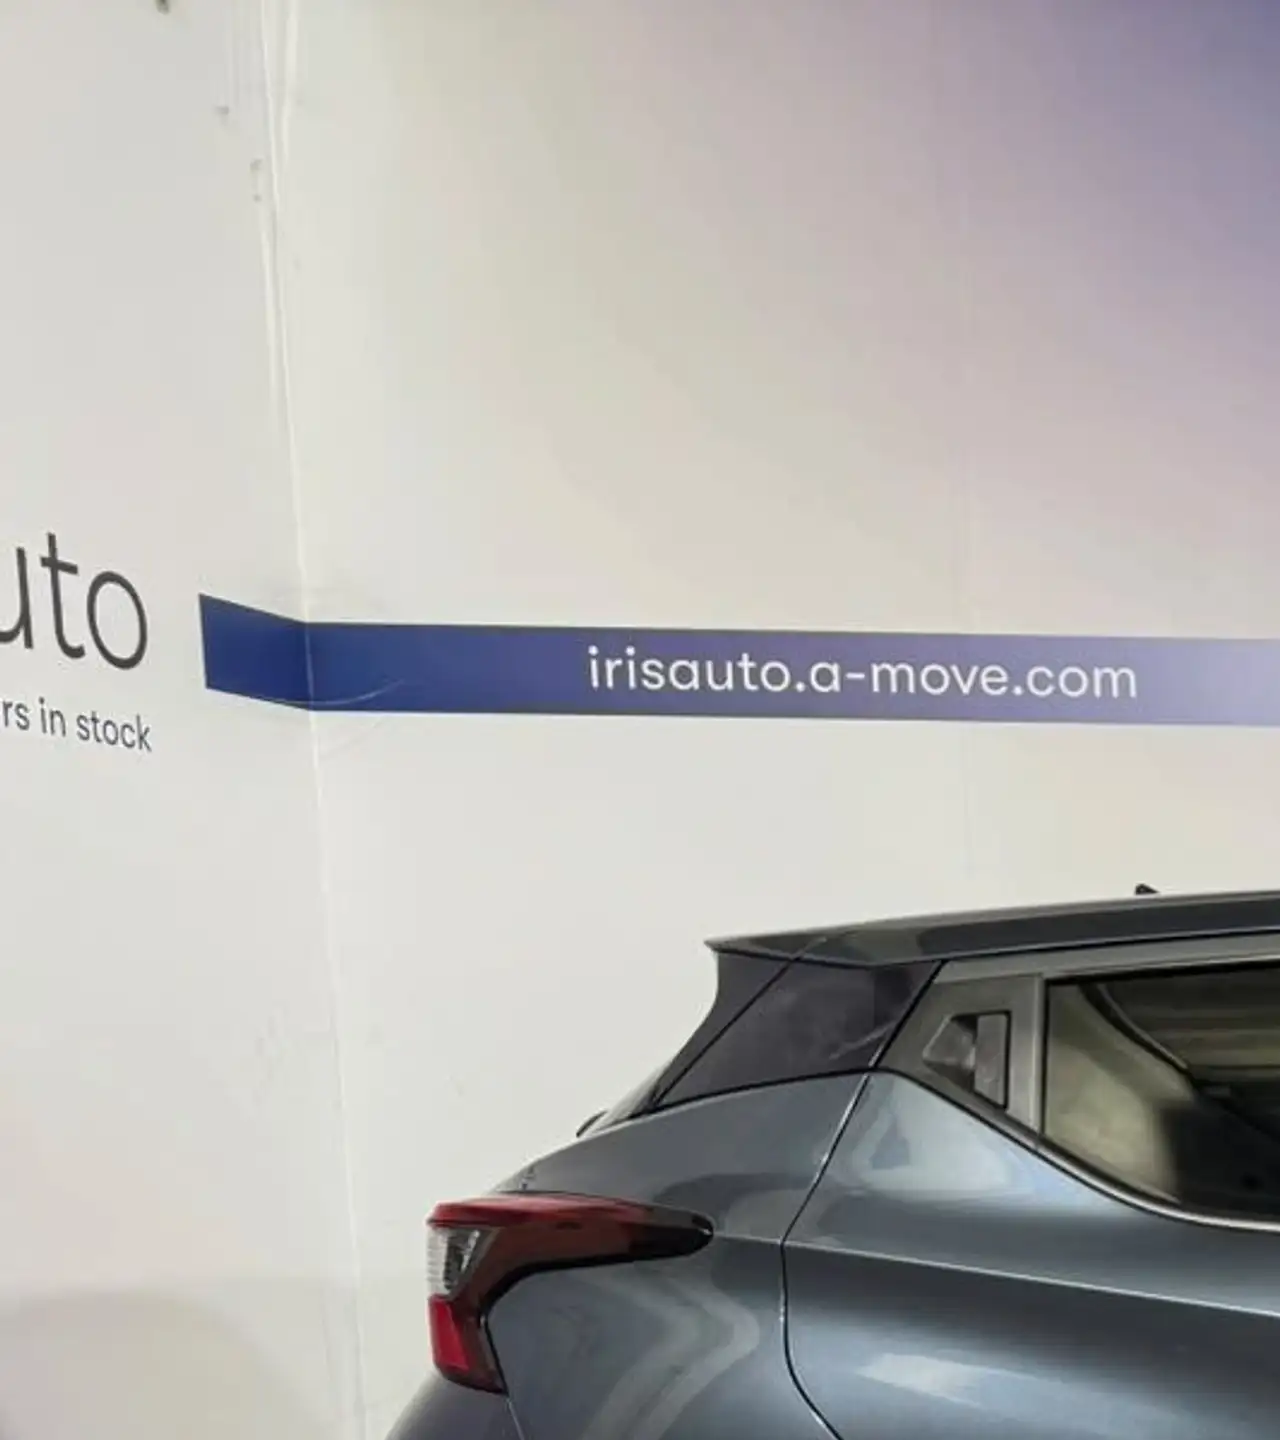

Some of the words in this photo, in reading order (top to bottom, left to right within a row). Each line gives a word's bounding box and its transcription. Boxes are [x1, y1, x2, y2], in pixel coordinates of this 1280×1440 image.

[588, 645, 1138, 698] irisauto.a-move.com
[39, 696, 67, 738] in
[76, 710, 153, 751] stock
